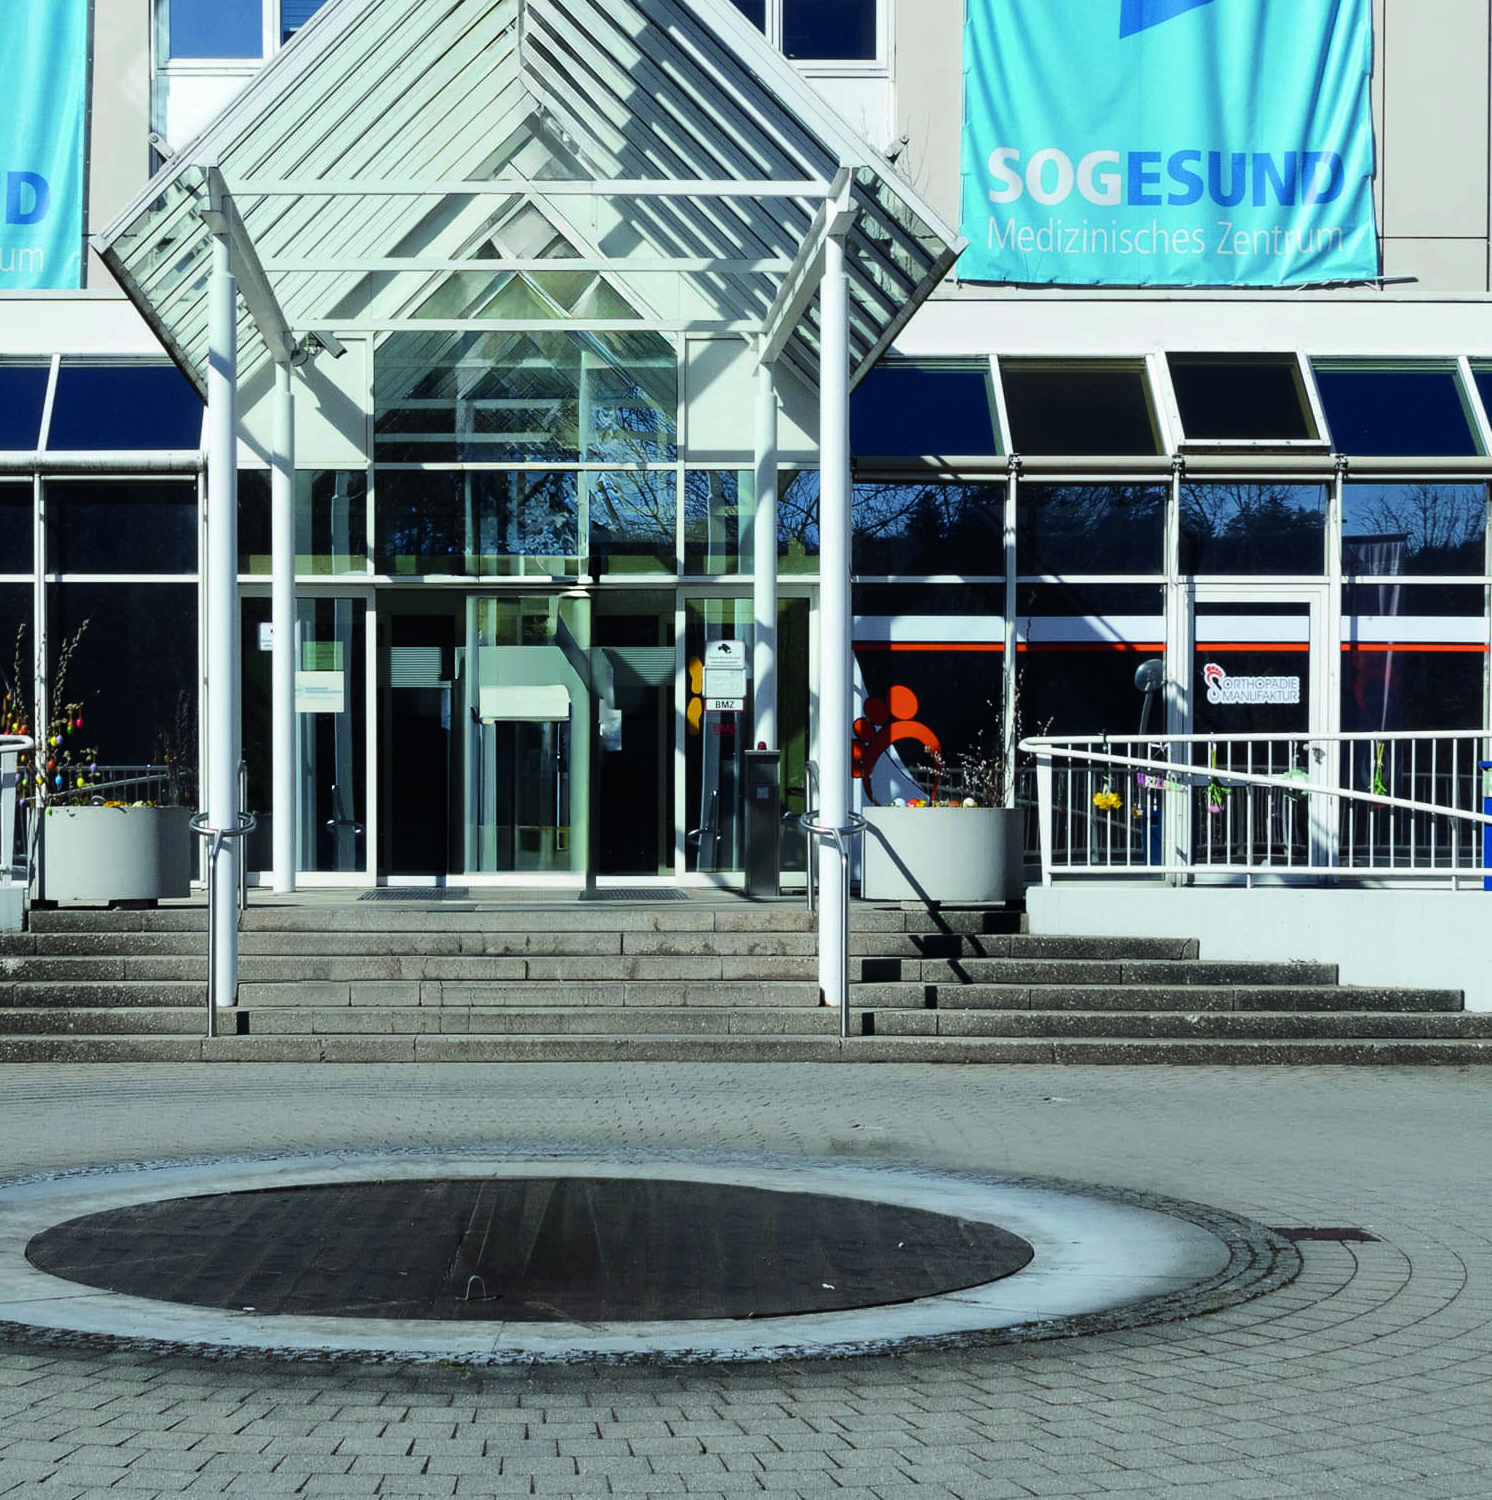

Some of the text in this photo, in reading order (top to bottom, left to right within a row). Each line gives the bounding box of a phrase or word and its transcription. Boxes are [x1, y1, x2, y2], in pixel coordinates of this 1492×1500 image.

[987, 147, 1345, 207] SOGESUND
[987, 216, 1343, 256] Medizinisches Zentrum
[715, 701, 735, 709] BMZ
[1222, 691, 1298, 701] MANUFAKTUR
